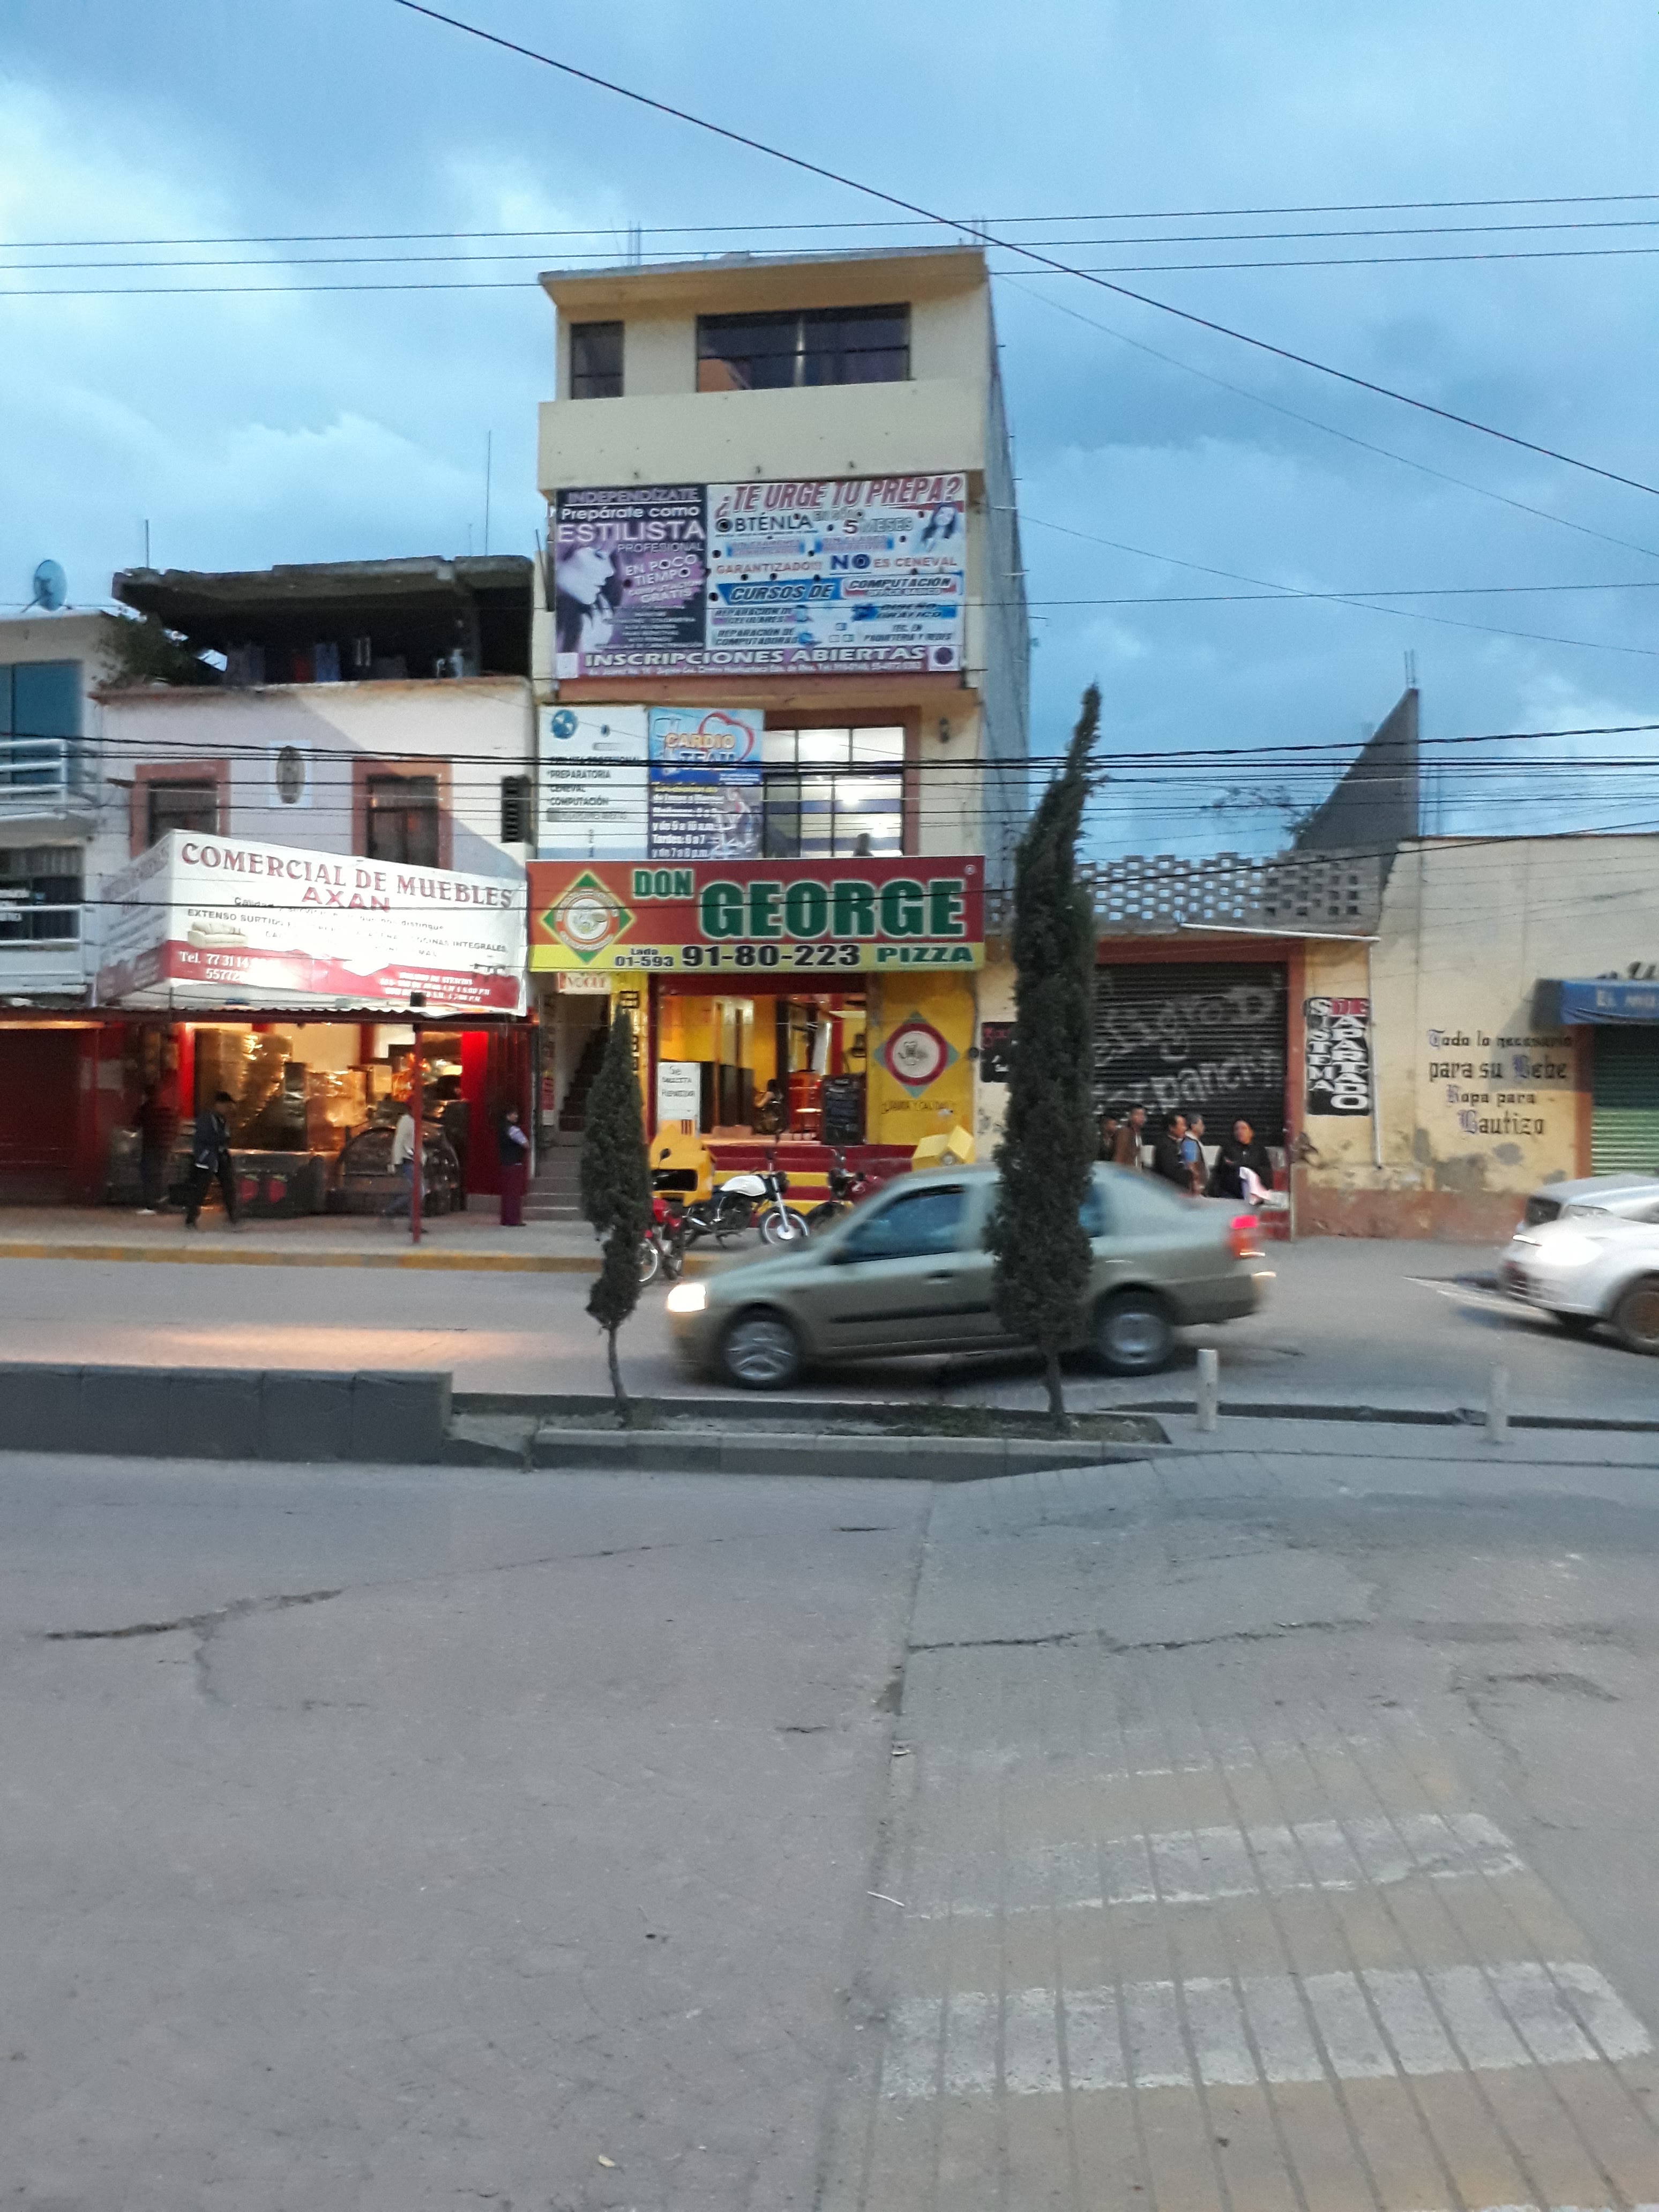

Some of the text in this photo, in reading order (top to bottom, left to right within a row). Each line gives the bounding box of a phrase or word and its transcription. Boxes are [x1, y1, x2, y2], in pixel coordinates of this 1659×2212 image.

[763, 483, 828, 511] URGE
[832, 481, 862, 508] TU
[864, 476, 962, 507] PREPA?
[562, 506, 700, 520] Prepárate como
[715, 511, 814, 533] OBTÉNLA
[558, 520, 706, 542] ESTILISTA
[843, 517, 912, 534] 5 MESES
[617, 542, 704, 553] PROFESIONAL
[626, 554, 697, 576] EN POCO
[831, 553, 870, 570] NO
[634, 567, 691, 586] TIEMPO
[729, 583, 835, 602] CURSOS DE
[585, 646, 926, 667] INSCRIPCIONES ABIERTAS
[664, 733, 736, 749] CARDIO
[550, 769, 611, 779] PREPARATORIA
[182, 842, 346, 886] COMERCIAL
[355, 868, 387, 892] DE
[397, 875, 513, 909] MUEBLES
[633, 869, 694, 899] DON
[302, 886, 390, 912] AXAN
[700, 879, 964, 938] GEORGE
[188, 908, 237, 921] EXTENSO
[452, 940, 507, 953] INTEGRALES
[206, 953, 220, 965] 77
[222, 954, 234, 967] 31
[615, 945, 973, 967] 01-593 91-80-223 PIZZA
[630, 947, 659, 955] Lada
[1307, 998, 1334, 1092] SISTEMA
[1331, 1015, 1369, 1109] APARTADO
[1429, 1062, 1473, 1082] para
[1479, 1063, 1503, 1079] su
[1497, 1093, 1536, 1107] para
[1458, 1109, 1544, 1135] Bautizo
